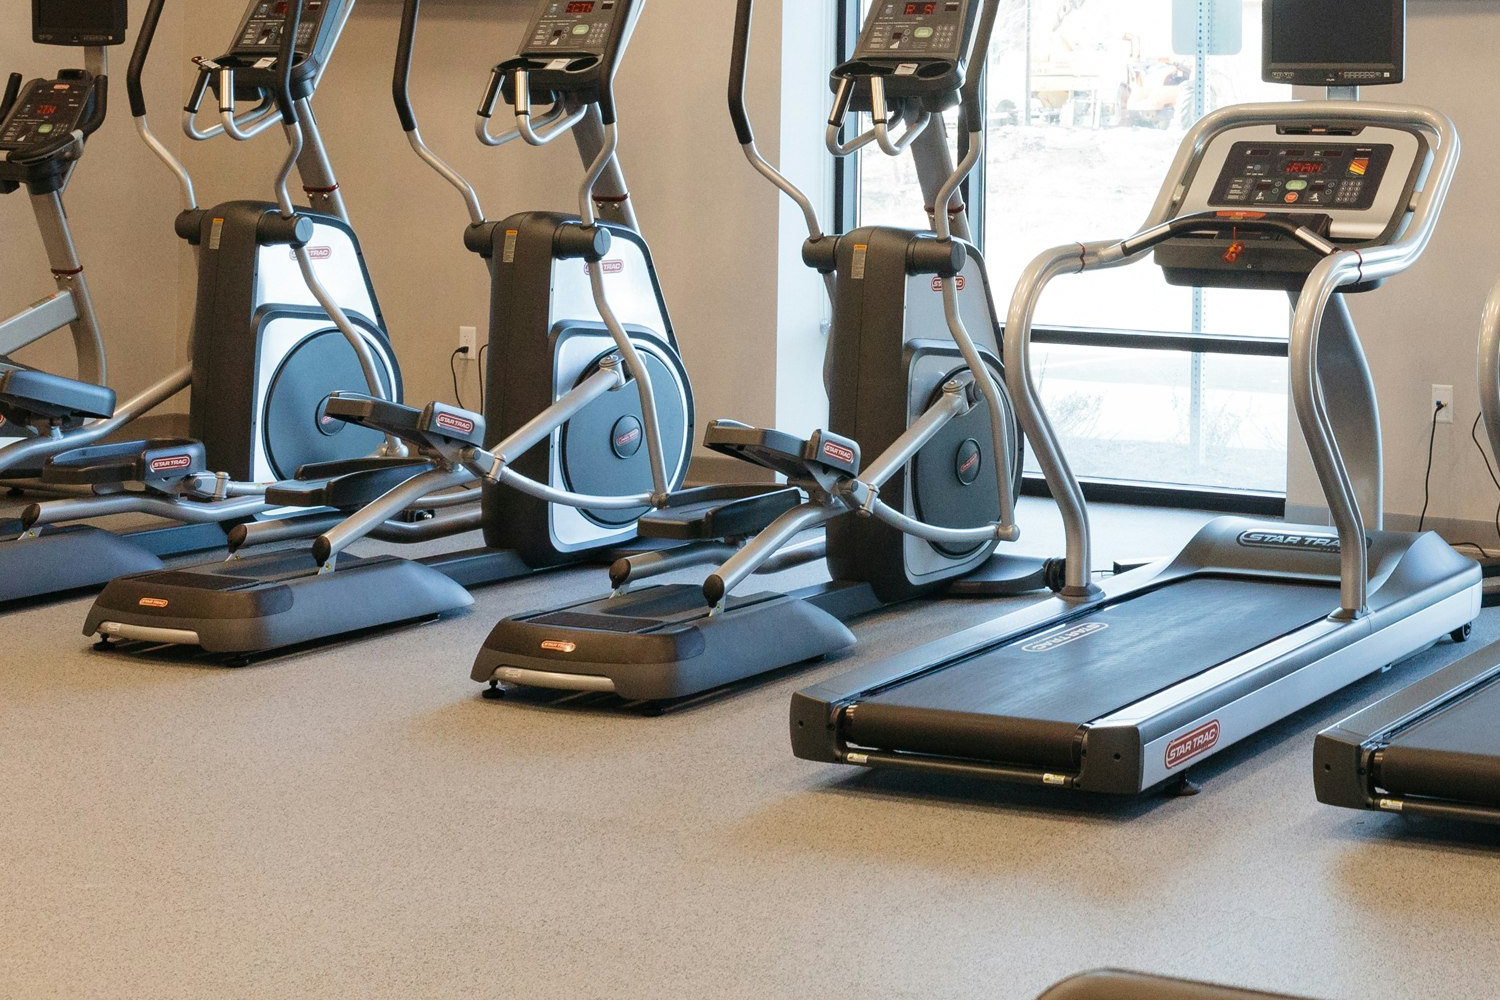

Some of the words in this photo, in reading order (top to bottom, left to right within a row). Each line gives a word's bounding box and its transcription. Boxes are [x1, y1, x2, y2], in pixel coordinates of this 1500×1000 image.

[440, 416, 455, 425] STAR
[454, 419, 471, 429] TRAC
[825, 445, 839, 455] STAR
[838, 449, 852, 458] TRAC
[153, 460, 171, 468] STAR
[170, 458, 188, 466] TRAC
[1249, 532, 1302, 544] STAR
[1304, 537, 1341, 547] TRA
[1170, 740, 1192, 760] STAR
[1193, 728, 1216, 748] TRAC
